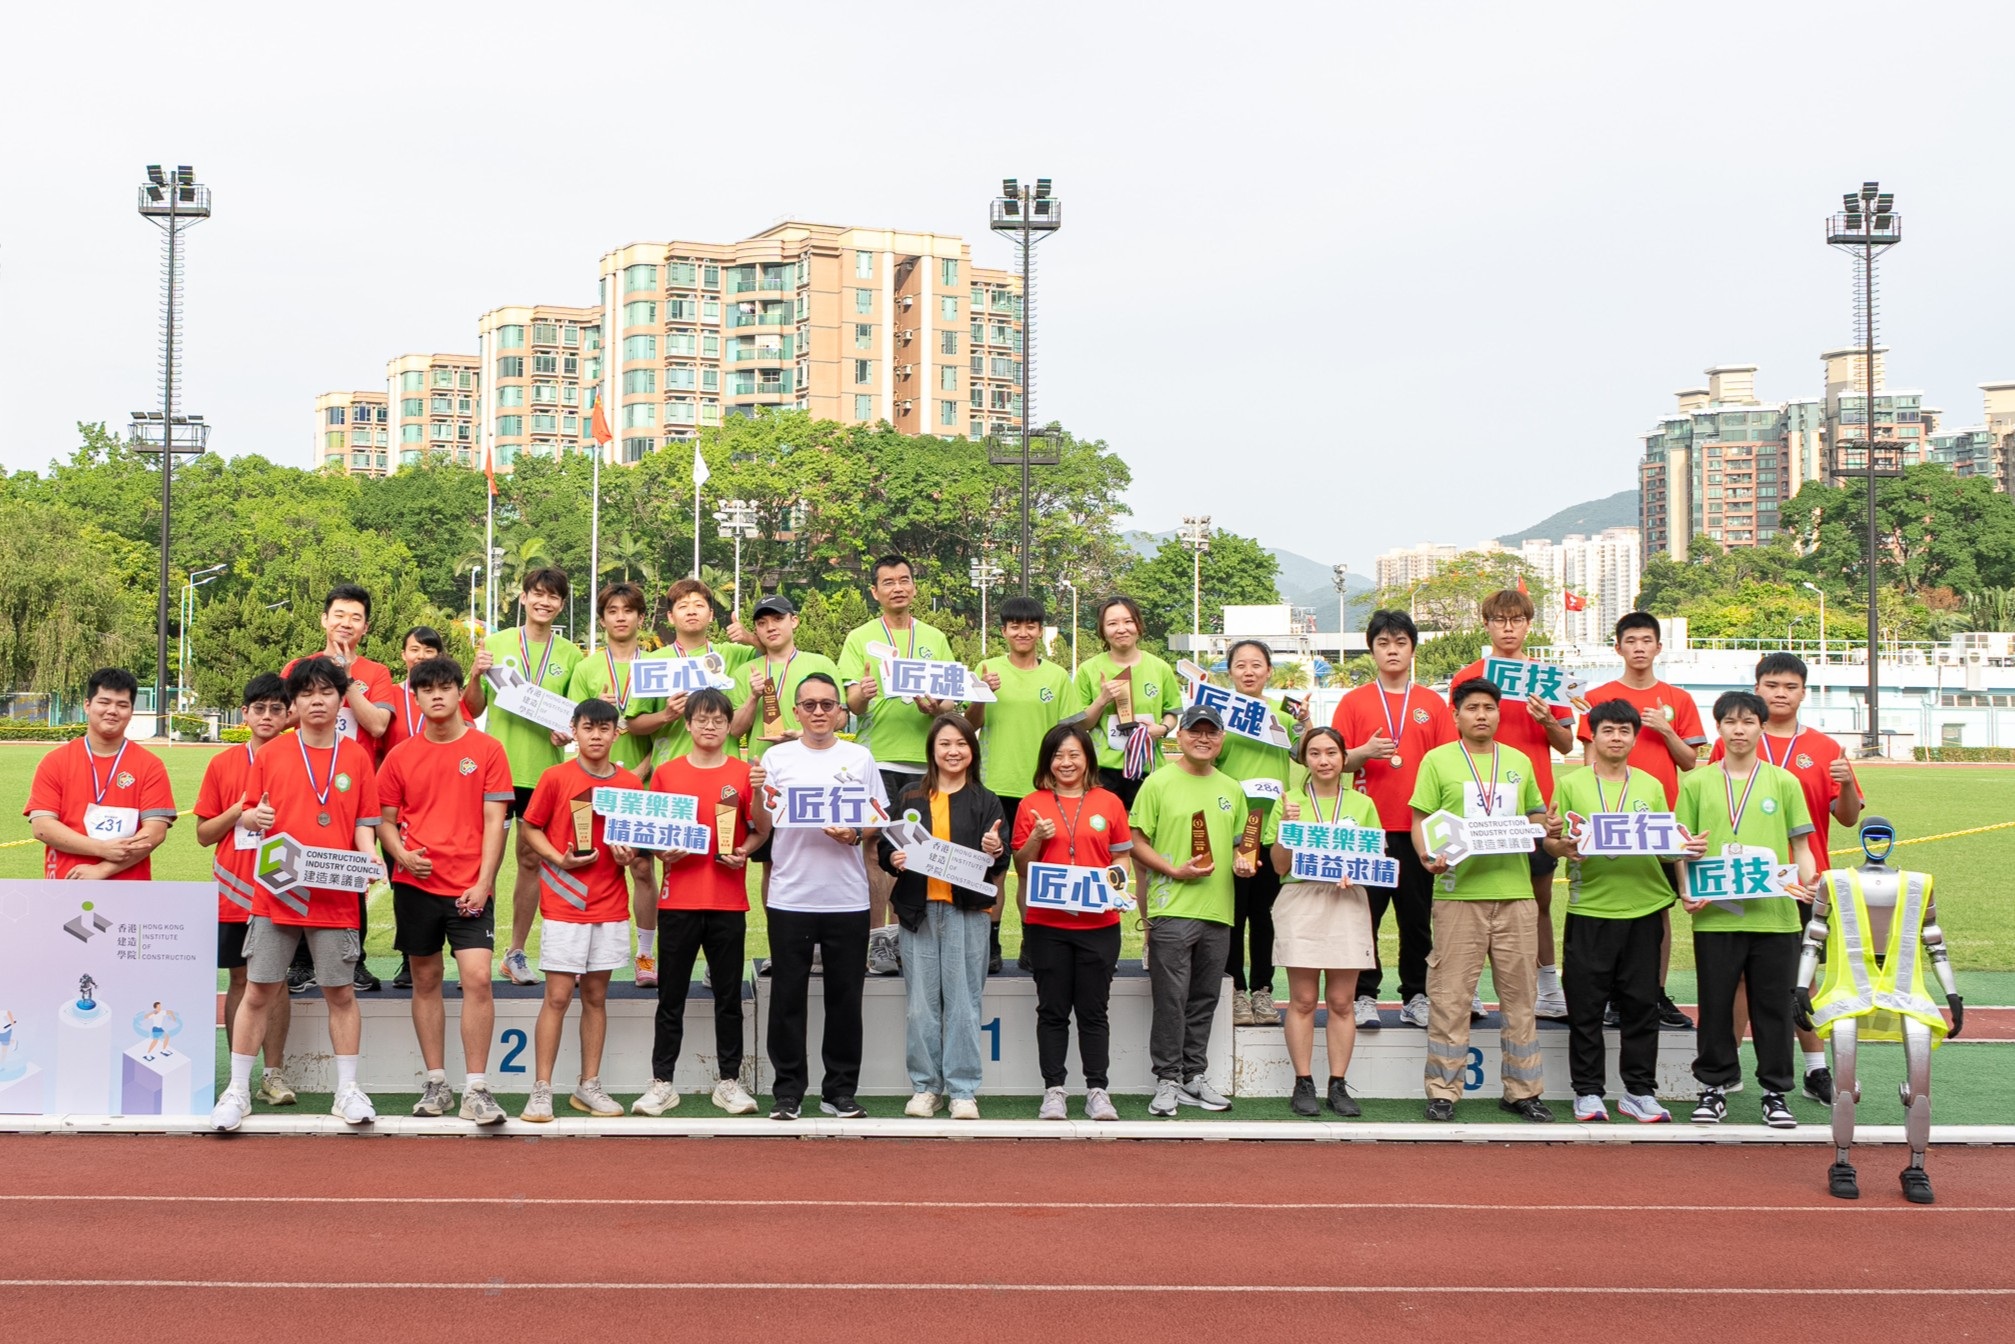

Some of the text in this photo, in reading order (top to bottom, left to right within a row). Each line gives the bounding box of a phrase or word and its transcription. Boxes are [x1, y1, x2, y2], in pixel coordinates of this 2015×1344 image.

[634, 660, 707, 693] 匠心
[892, 660, 964, 697] 匠魂
[1487, 659, 1563, 701] 匠技
[1194, 683, 1266, 736] 匠魂
[1254, 782, 1280, 794] 284
[1476, 792, 1502, 808] 31
[595, 789, 694, 821] 專業樂業
[788, 786, 866, 823] 匠行
[606, 818, 707, 850] 精益求精
[1468, 820, 1526, 829] CONSTRUCTION
[1470, 827, 1542, 837] INDUSTRY COUNCIL
[1592, 813, 1673, 850] 匠行
[932, 841, 950, 853] 香港
[1281, 823, 1381, 854] 專業樂業
[305, 860, 381, 875] INDUSTRY COUNCIL
[306, 850, 367, 864] CONSTRUCTION
[928, 852, 946, 865] 建造
[952, 856, 983, 871] INSTITUTE
[954, 847, 991, 864] HONG KONG
[1294, 852, 1395, 883] 精益求精
[303, 870, 366, 889] 建造業議會
[946, 873, 994, 893] CONSTRUCTION
[1030, 865, 1108, 908] 匠心
[1687, 857, 1773, 897] 匠技
[117, 923, 137, 934] 香港
[117, 937, 137, 947] 建造
[117, 950, 137, 960] 學院
[499, 1028, 528, 1073] 2
[981, 1017, 1000, 1061] 1
[1463, 1046, 1484, 1091] 3
